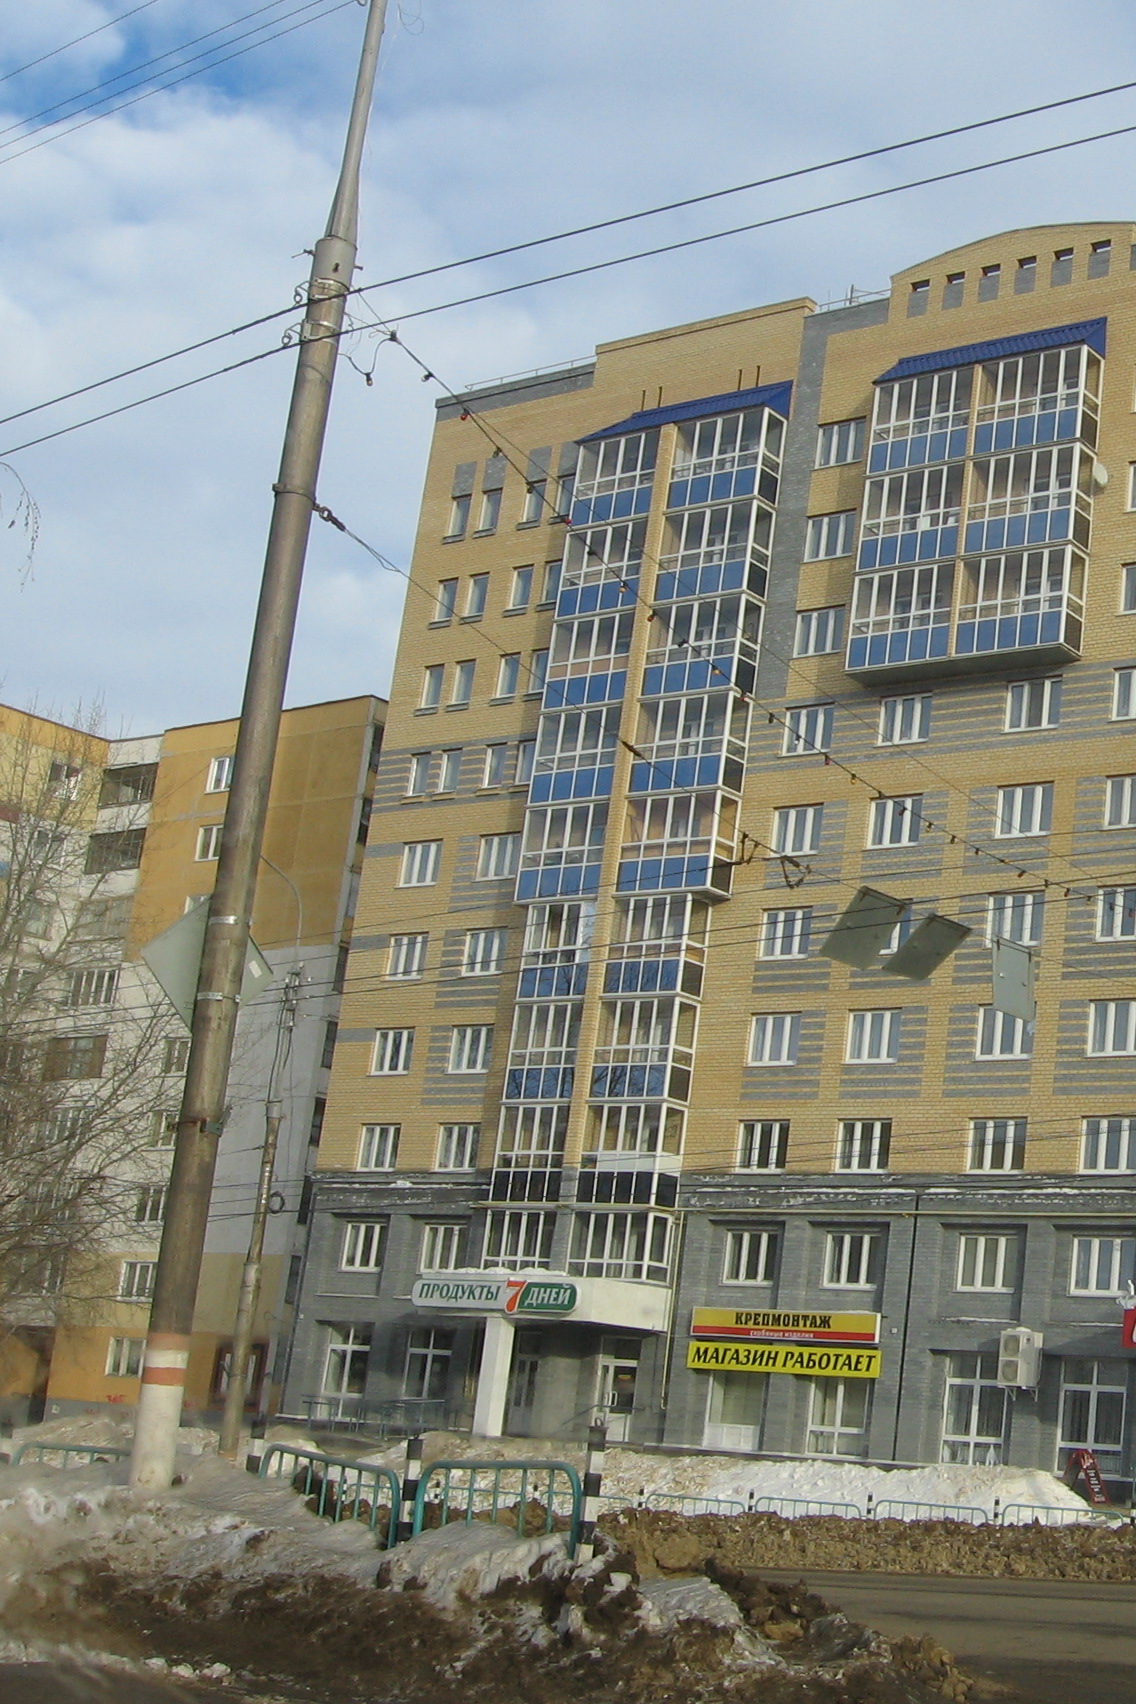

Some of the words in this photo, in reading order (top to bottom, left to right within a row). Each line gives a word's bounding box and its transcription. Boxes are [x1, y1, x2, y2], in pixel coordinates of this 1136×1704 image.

[419, 1281, 500, 1301] ПРОДУКТЫ
[504, 1279, 527, 1313] 7
[524, 1284, 573, 1306] ДНЕЙ
[734, 1311, 832, 1329] КРЕПМОНТАЖ
[691, 1346, 778, 1367] МАГАЗИН
[782, 1350, 876, 1372] РАБОТАЕТ
